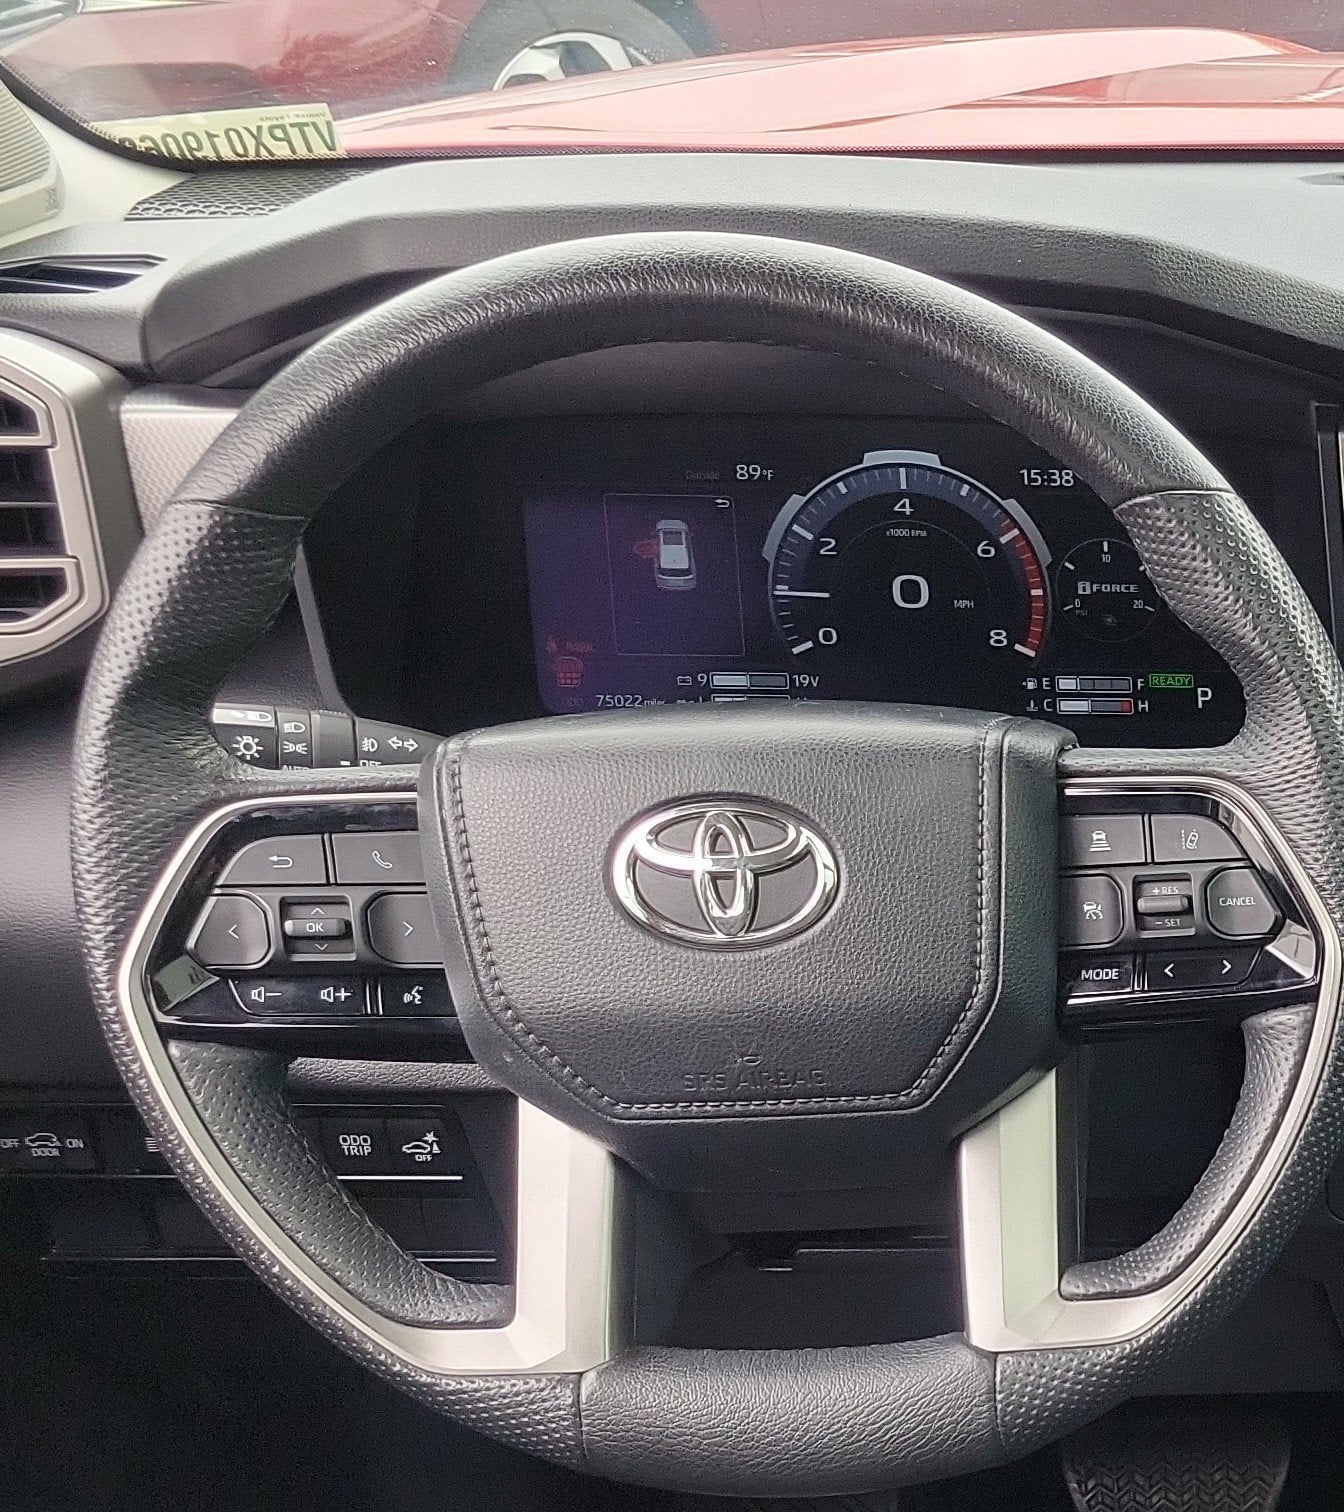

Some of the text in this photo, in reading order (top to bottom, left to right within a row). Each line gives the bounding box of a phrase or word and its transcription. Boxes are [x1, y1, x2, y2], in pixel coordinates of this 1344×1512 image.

[1019, 469, 1075, 487] 15:38
[893, 498, 914, 515] 4
[819, 538, 838, 555] 2
[976, 540, 996, 558] 6
[1101, 553, 1111, 563] 10
[892, 574, 929, 609] 0
[953, 599, 975, 608] MPH
[818, 627, 838, 645] 0
[989, 630, 1008, 647] 8
[1043, 678, 1051, 689] E
[1137, 679, 1145, 691] F
[1151, 675, 1192, 687] READY
[1197, 688, 1212, 708] P
[1043, 699, 1053, 712] C
[1138, 701, 1149, 712] H
[1219, 896, 1256, 907] CANCEL
[306, 922, 325, 932] OK
[1081, 968, 1120, 981] MODE
[66, 1138, 85, 1149] ON
[339, 1134, 371, 1146] ODO
[341, 1146, 372, 1157] TRIP
[415, 1154, 433, 1162] OFF
